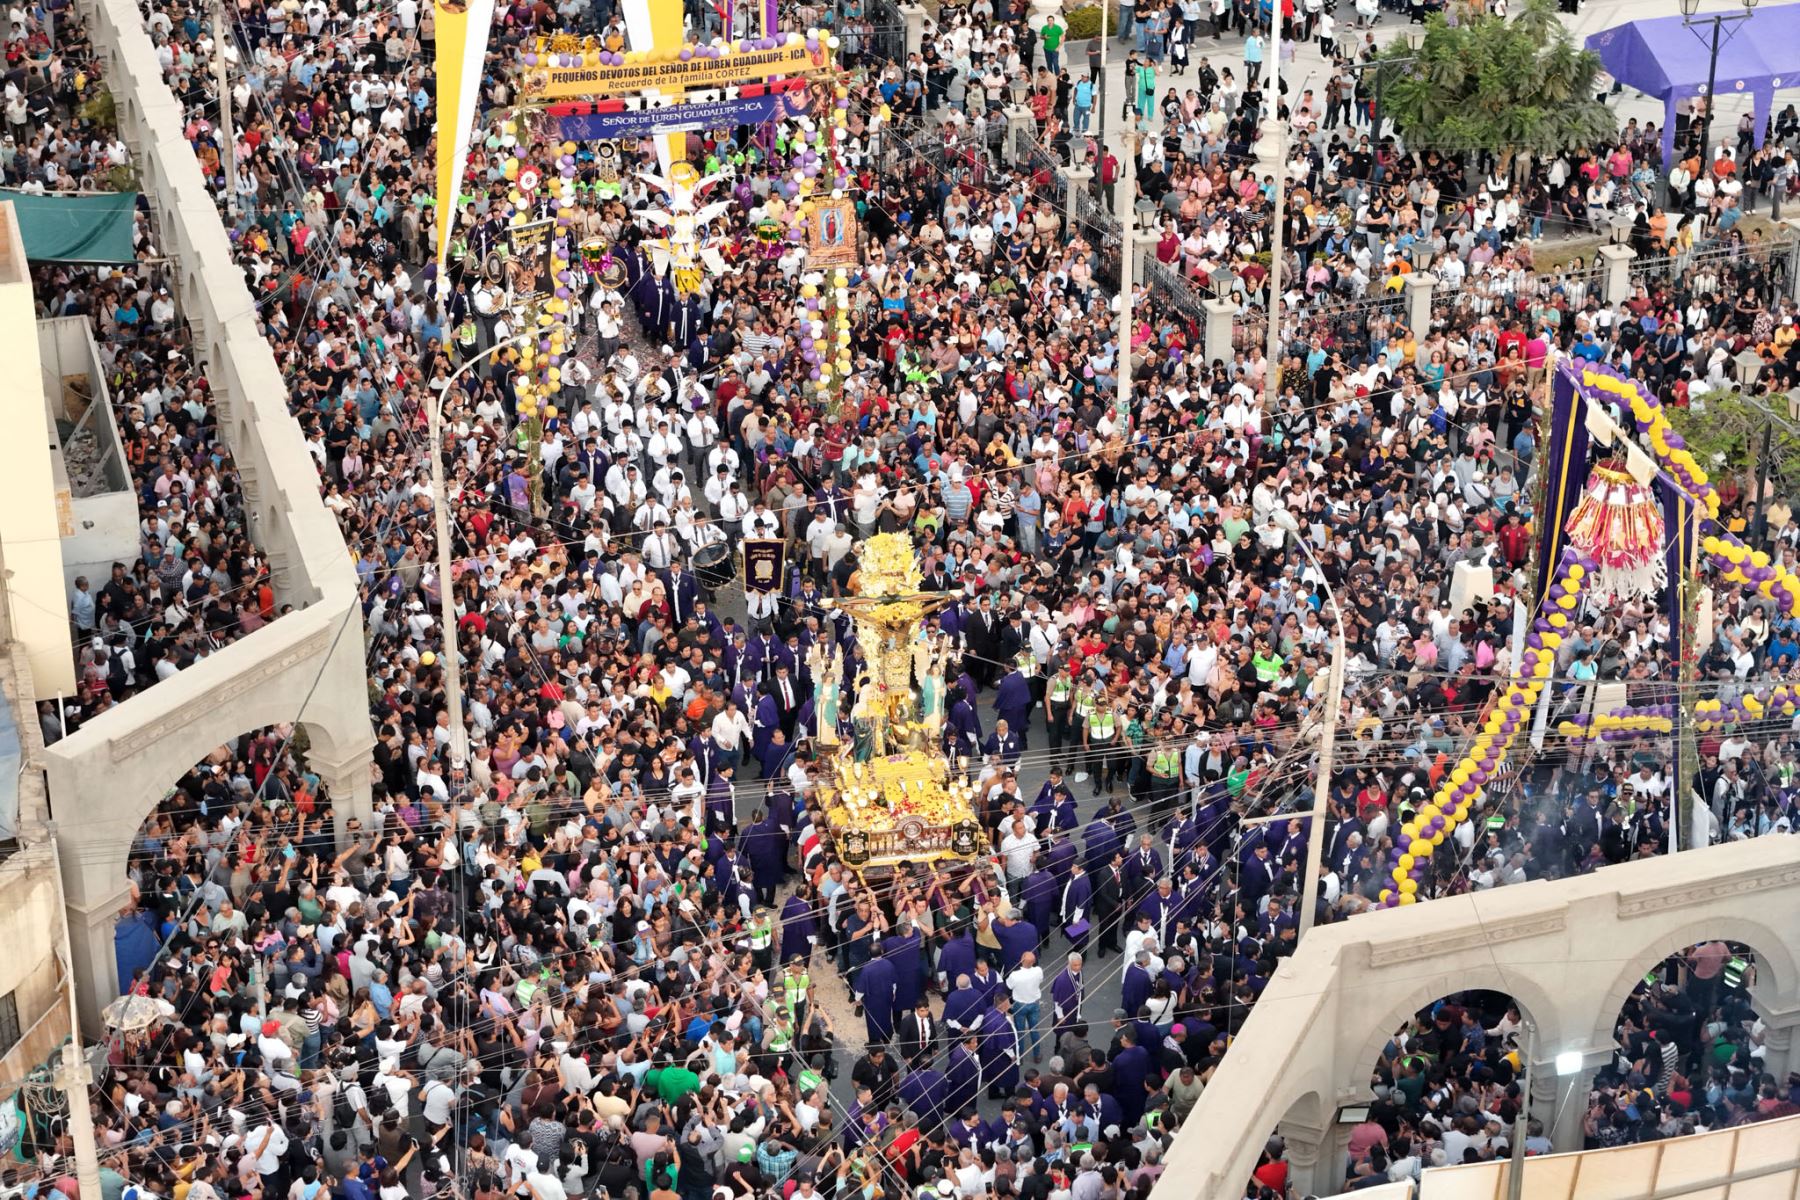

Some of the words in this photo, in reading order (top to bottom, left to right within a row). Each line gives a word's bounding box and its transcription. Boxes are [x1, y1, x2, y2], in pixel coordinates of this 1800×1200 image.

[552, 70, 598, 83] PEQUEÑOS
[600, 67, 640, 80] DEVOTOS
[642, 66, 657, 76] DEL
[659, 62, 689, 75] SEÑOR
[690, 62, 701, 71] DE
[703, 59, 731, 70] LUREN
[733, 51, 783, 67] GUADALUPE
[790, 49, 805, 60] ICA
[608, 77, 652, 89] Recuerdo
[655, 77, 667, 85] de
[669, 75, 678, 84] la
[680, 71, 713, 84] familia
[715, 67, 750, 79] CORTEZ
[602, 116, 637, 127] SEÑOR
[639, 116, 650, 124] DE
[651, 112, 681, 123] LUREN
